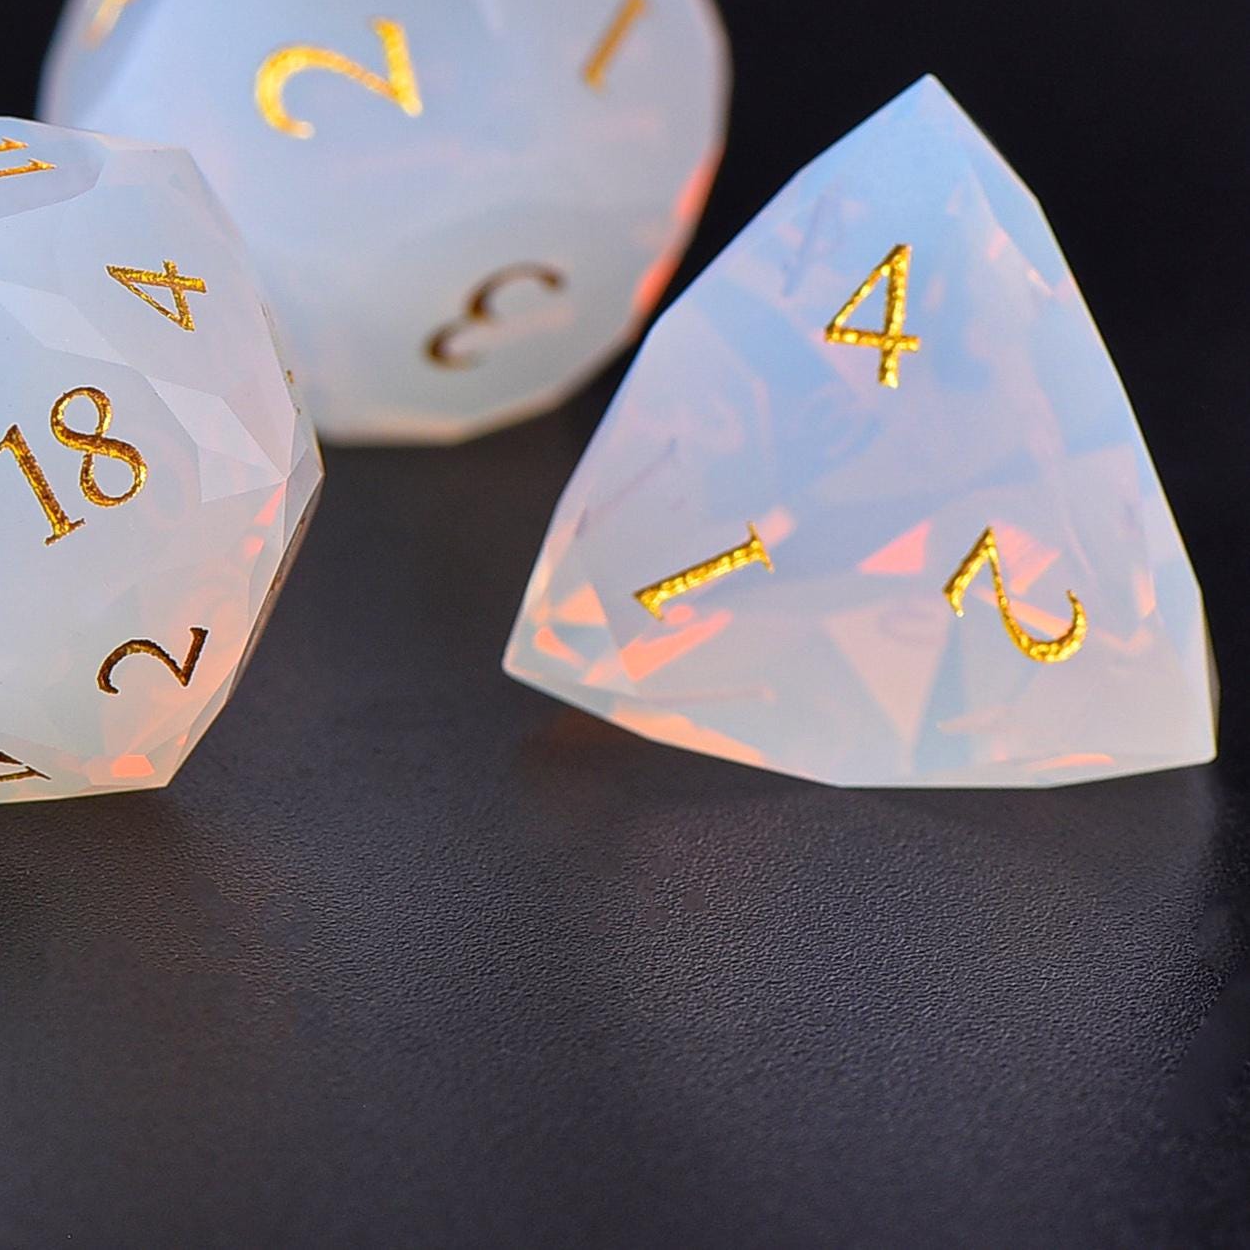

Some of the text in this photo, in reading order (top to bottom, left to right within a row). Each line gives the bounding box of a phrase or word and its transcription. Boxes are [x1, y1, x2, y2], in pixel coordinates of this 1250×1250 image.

[254, 14, 424, 140] 2
[105, 259, 207, 332] 4
[423, 259, 568, 370] 3
[823, 243, 921, 388] 4
[632, 520, 775, 620] 1
[943, 526, 1087, 664] 2
[96, 625, 210, 695] 2
